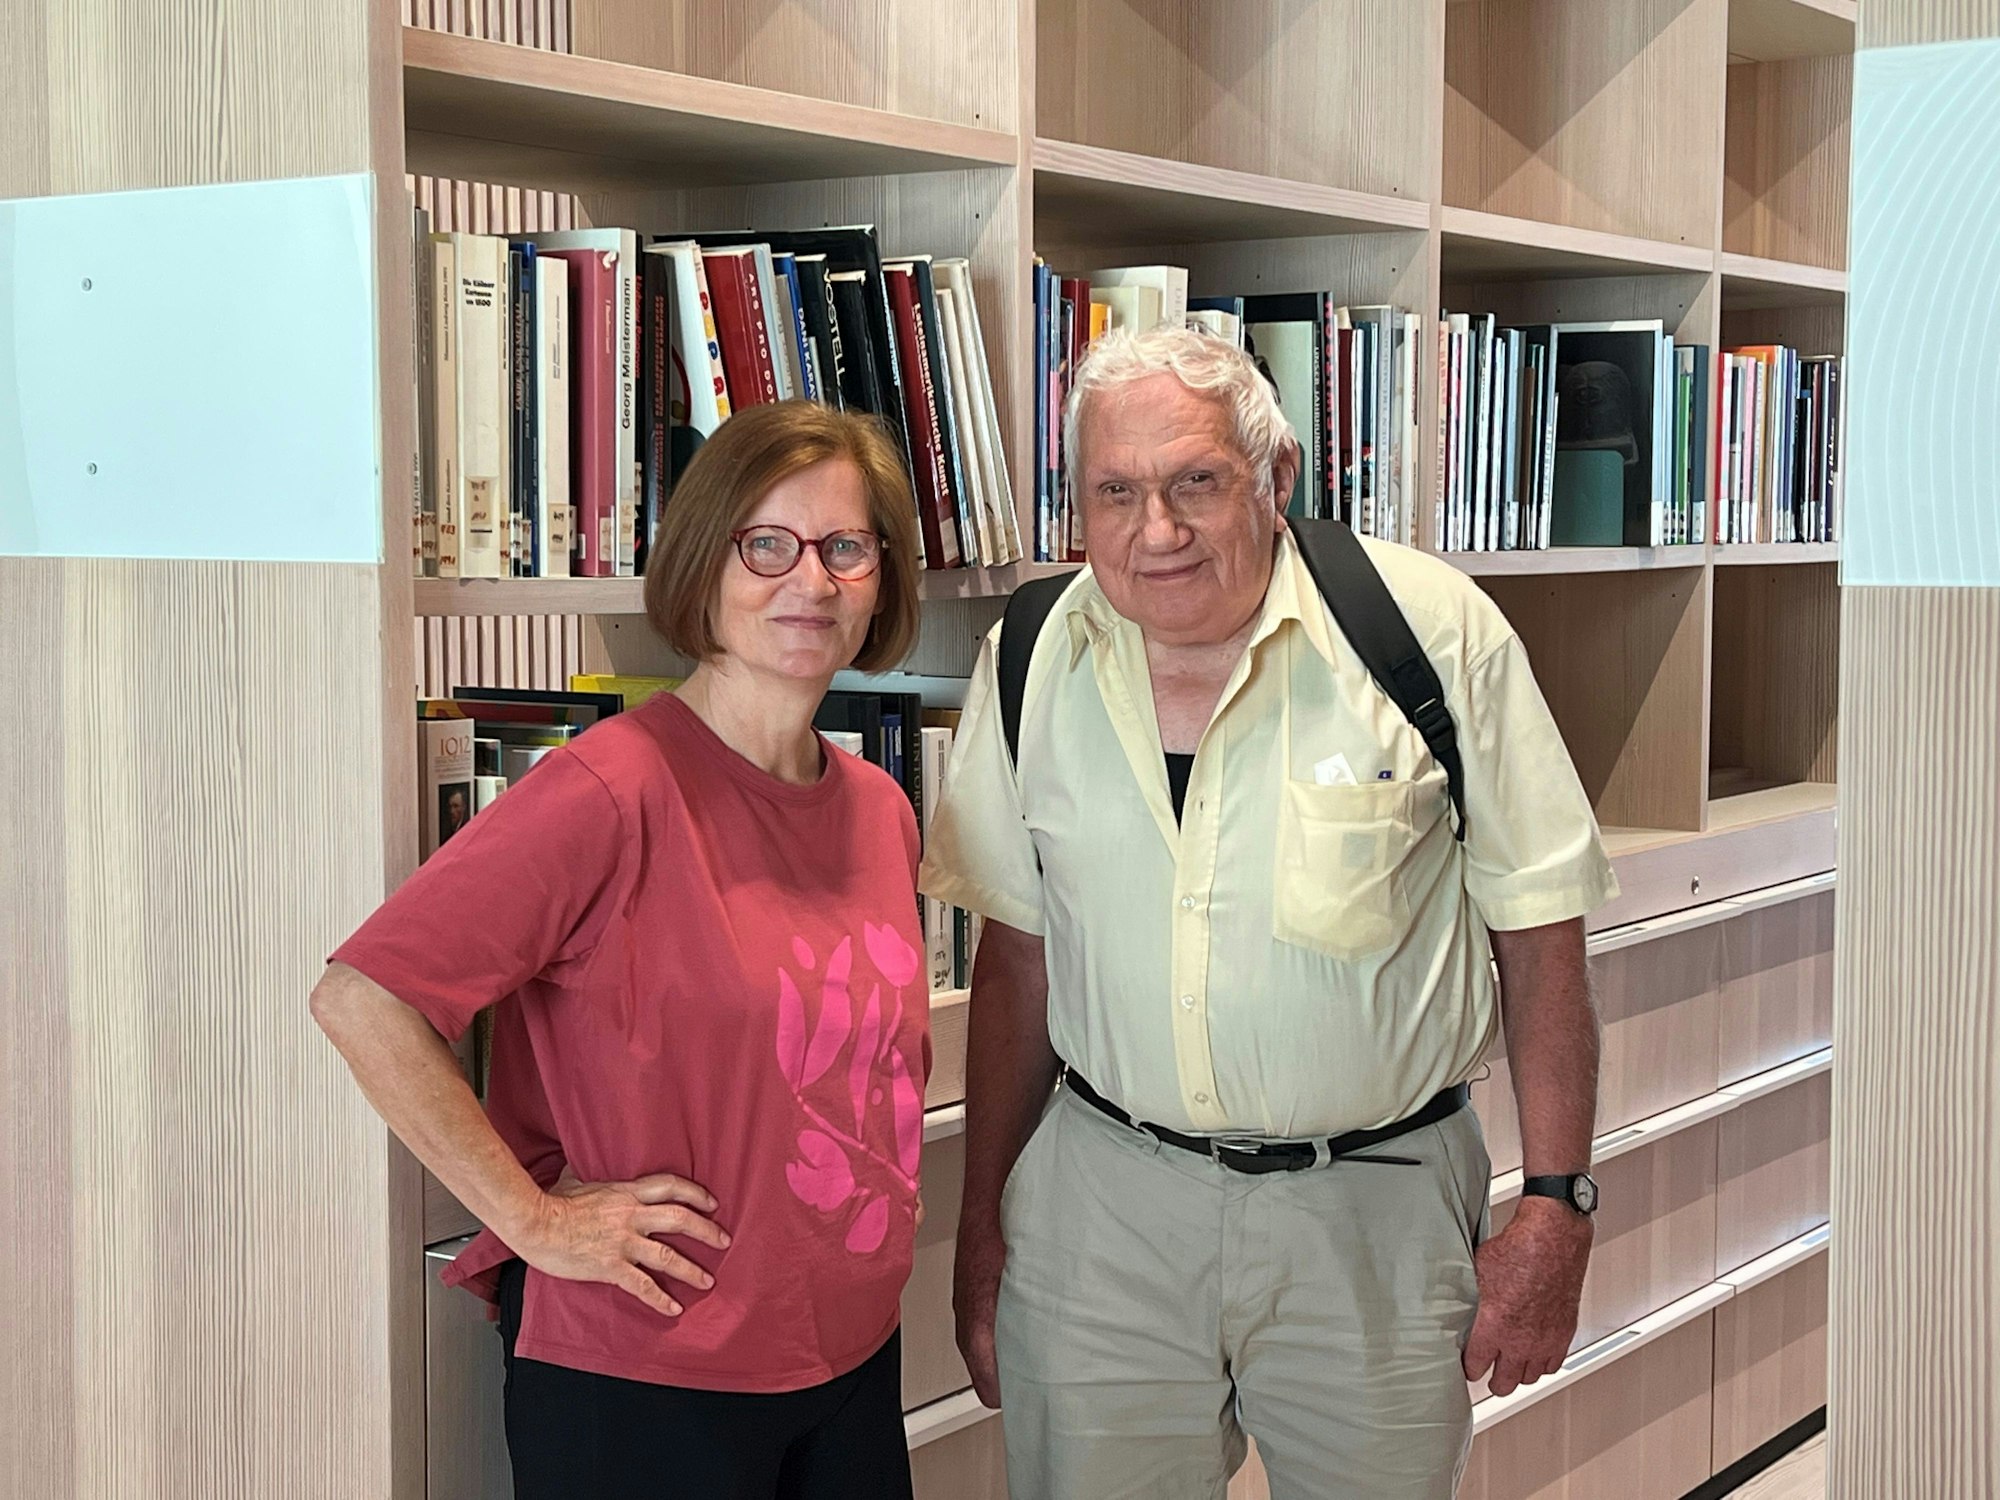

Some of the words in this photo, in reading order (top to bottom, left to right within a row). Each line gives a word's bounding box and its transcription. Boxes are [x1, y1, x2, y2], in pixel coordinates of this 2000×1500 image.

[622, 278, 631, 378] Meistermann
[749, 273, 759, 311] ARS
[756, 320, 768, 359] PRO
[798, 307, 808, 348] DANI
[823, 268, 845, 387] VOSTELL
[622, 380, 632, 429] Georg
[913, 302, 943, 452] Lateinamerikanische
[936, 454, 950, 497] Kunst
[1313, 346, 1321, 385] UNSER
[1313, 390, 1322, 472] JAHRHUNDERT
[913, 732, 922, 831] TINTORE
